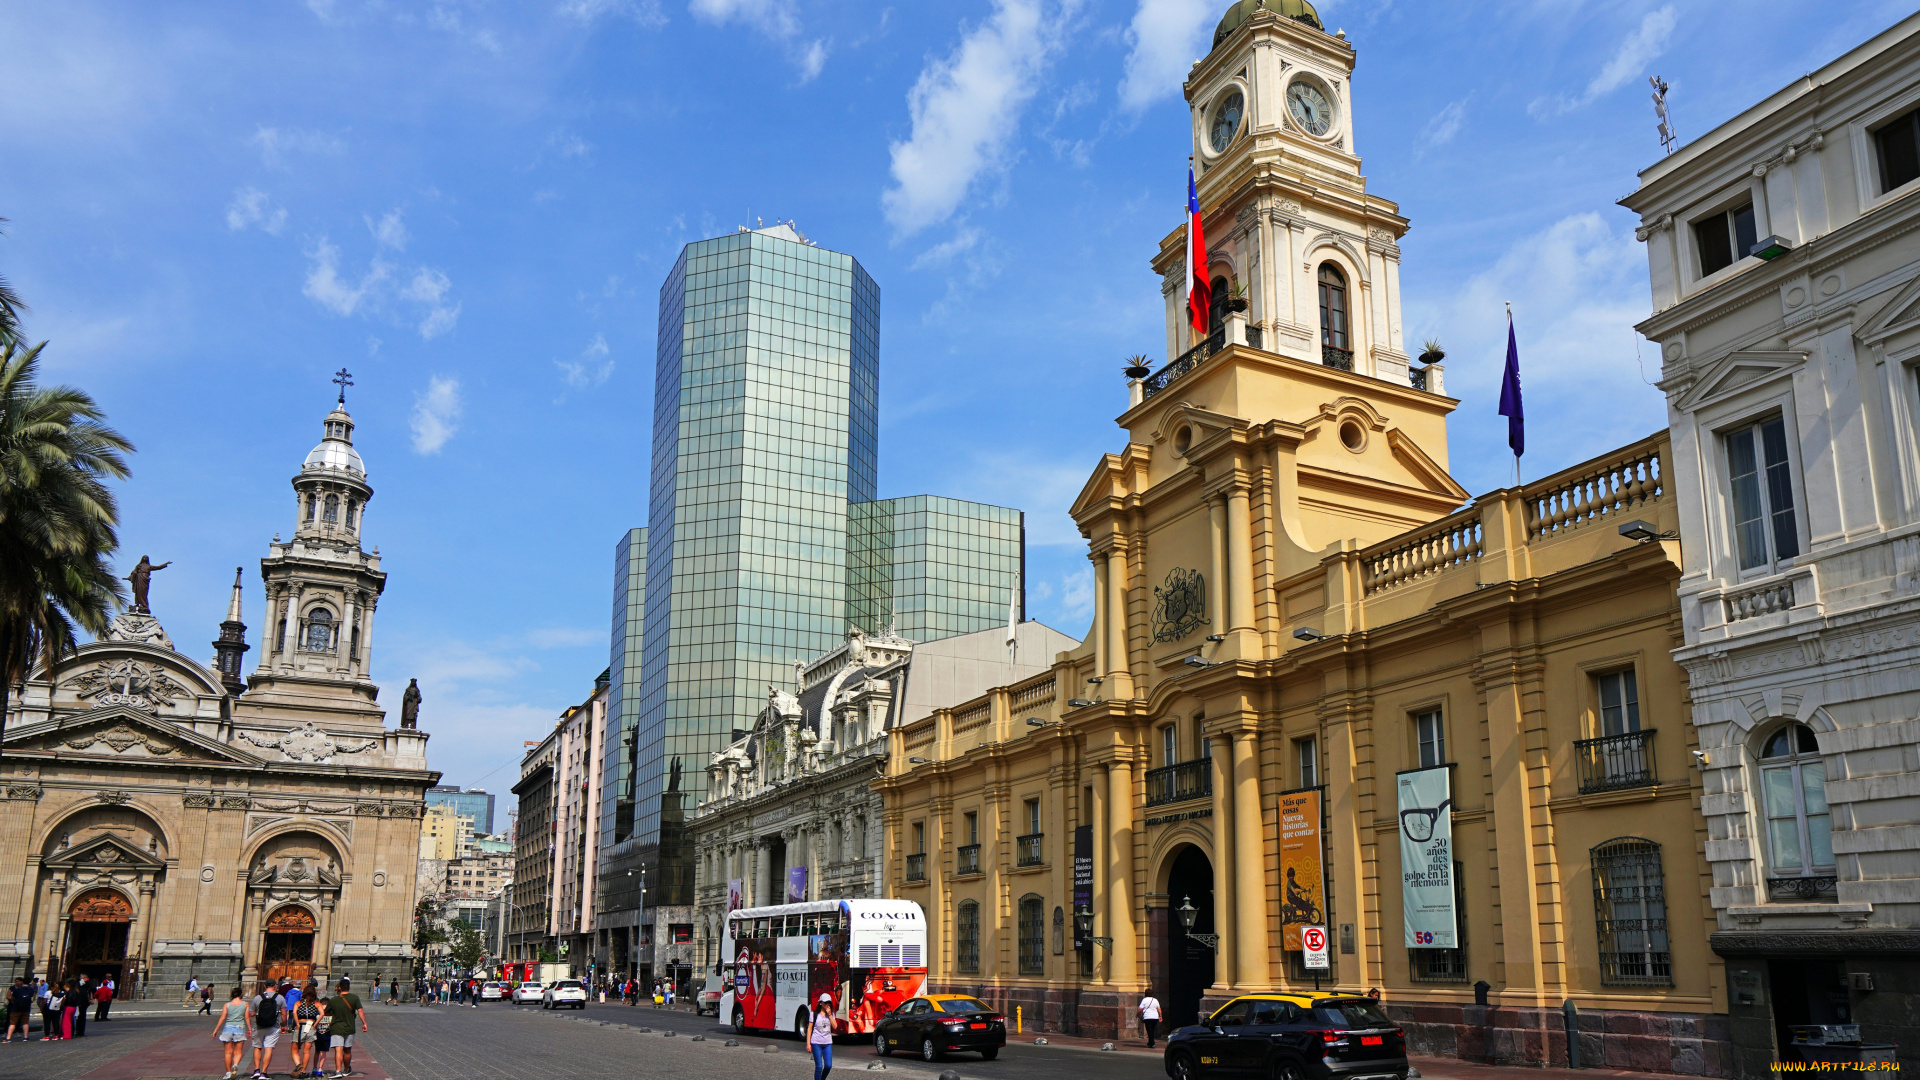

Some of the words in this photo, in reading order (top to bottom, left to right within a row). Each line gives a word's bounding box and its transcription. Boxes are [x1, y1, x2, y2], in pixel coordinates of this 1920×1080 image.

[1282, 798, 1295, 807] Más
[1295, 798, 1307, 806] que
[1282, 806, 1299, 815] cosas
[1282, 814, 1304, 822] Nuevas
[1282, 821, 1309, 831] historias
[1282, 832, 1294, 840] que
[1294, 829, 1315, 838] contar
[1435, 838, 1447, 848] 50
[1426, 846, 1448, 857] años
[1432, 855, 1448, 863] des
[1404, 870, 1426, 883] golpe
[1427, 870, 1438, 879] en
[1440, 869, 1449, 879] la
[1410, 878, 1449, 888] memoria
[861, 912, 915, 920] COACH
[777, 971, 807, 982] COACH
